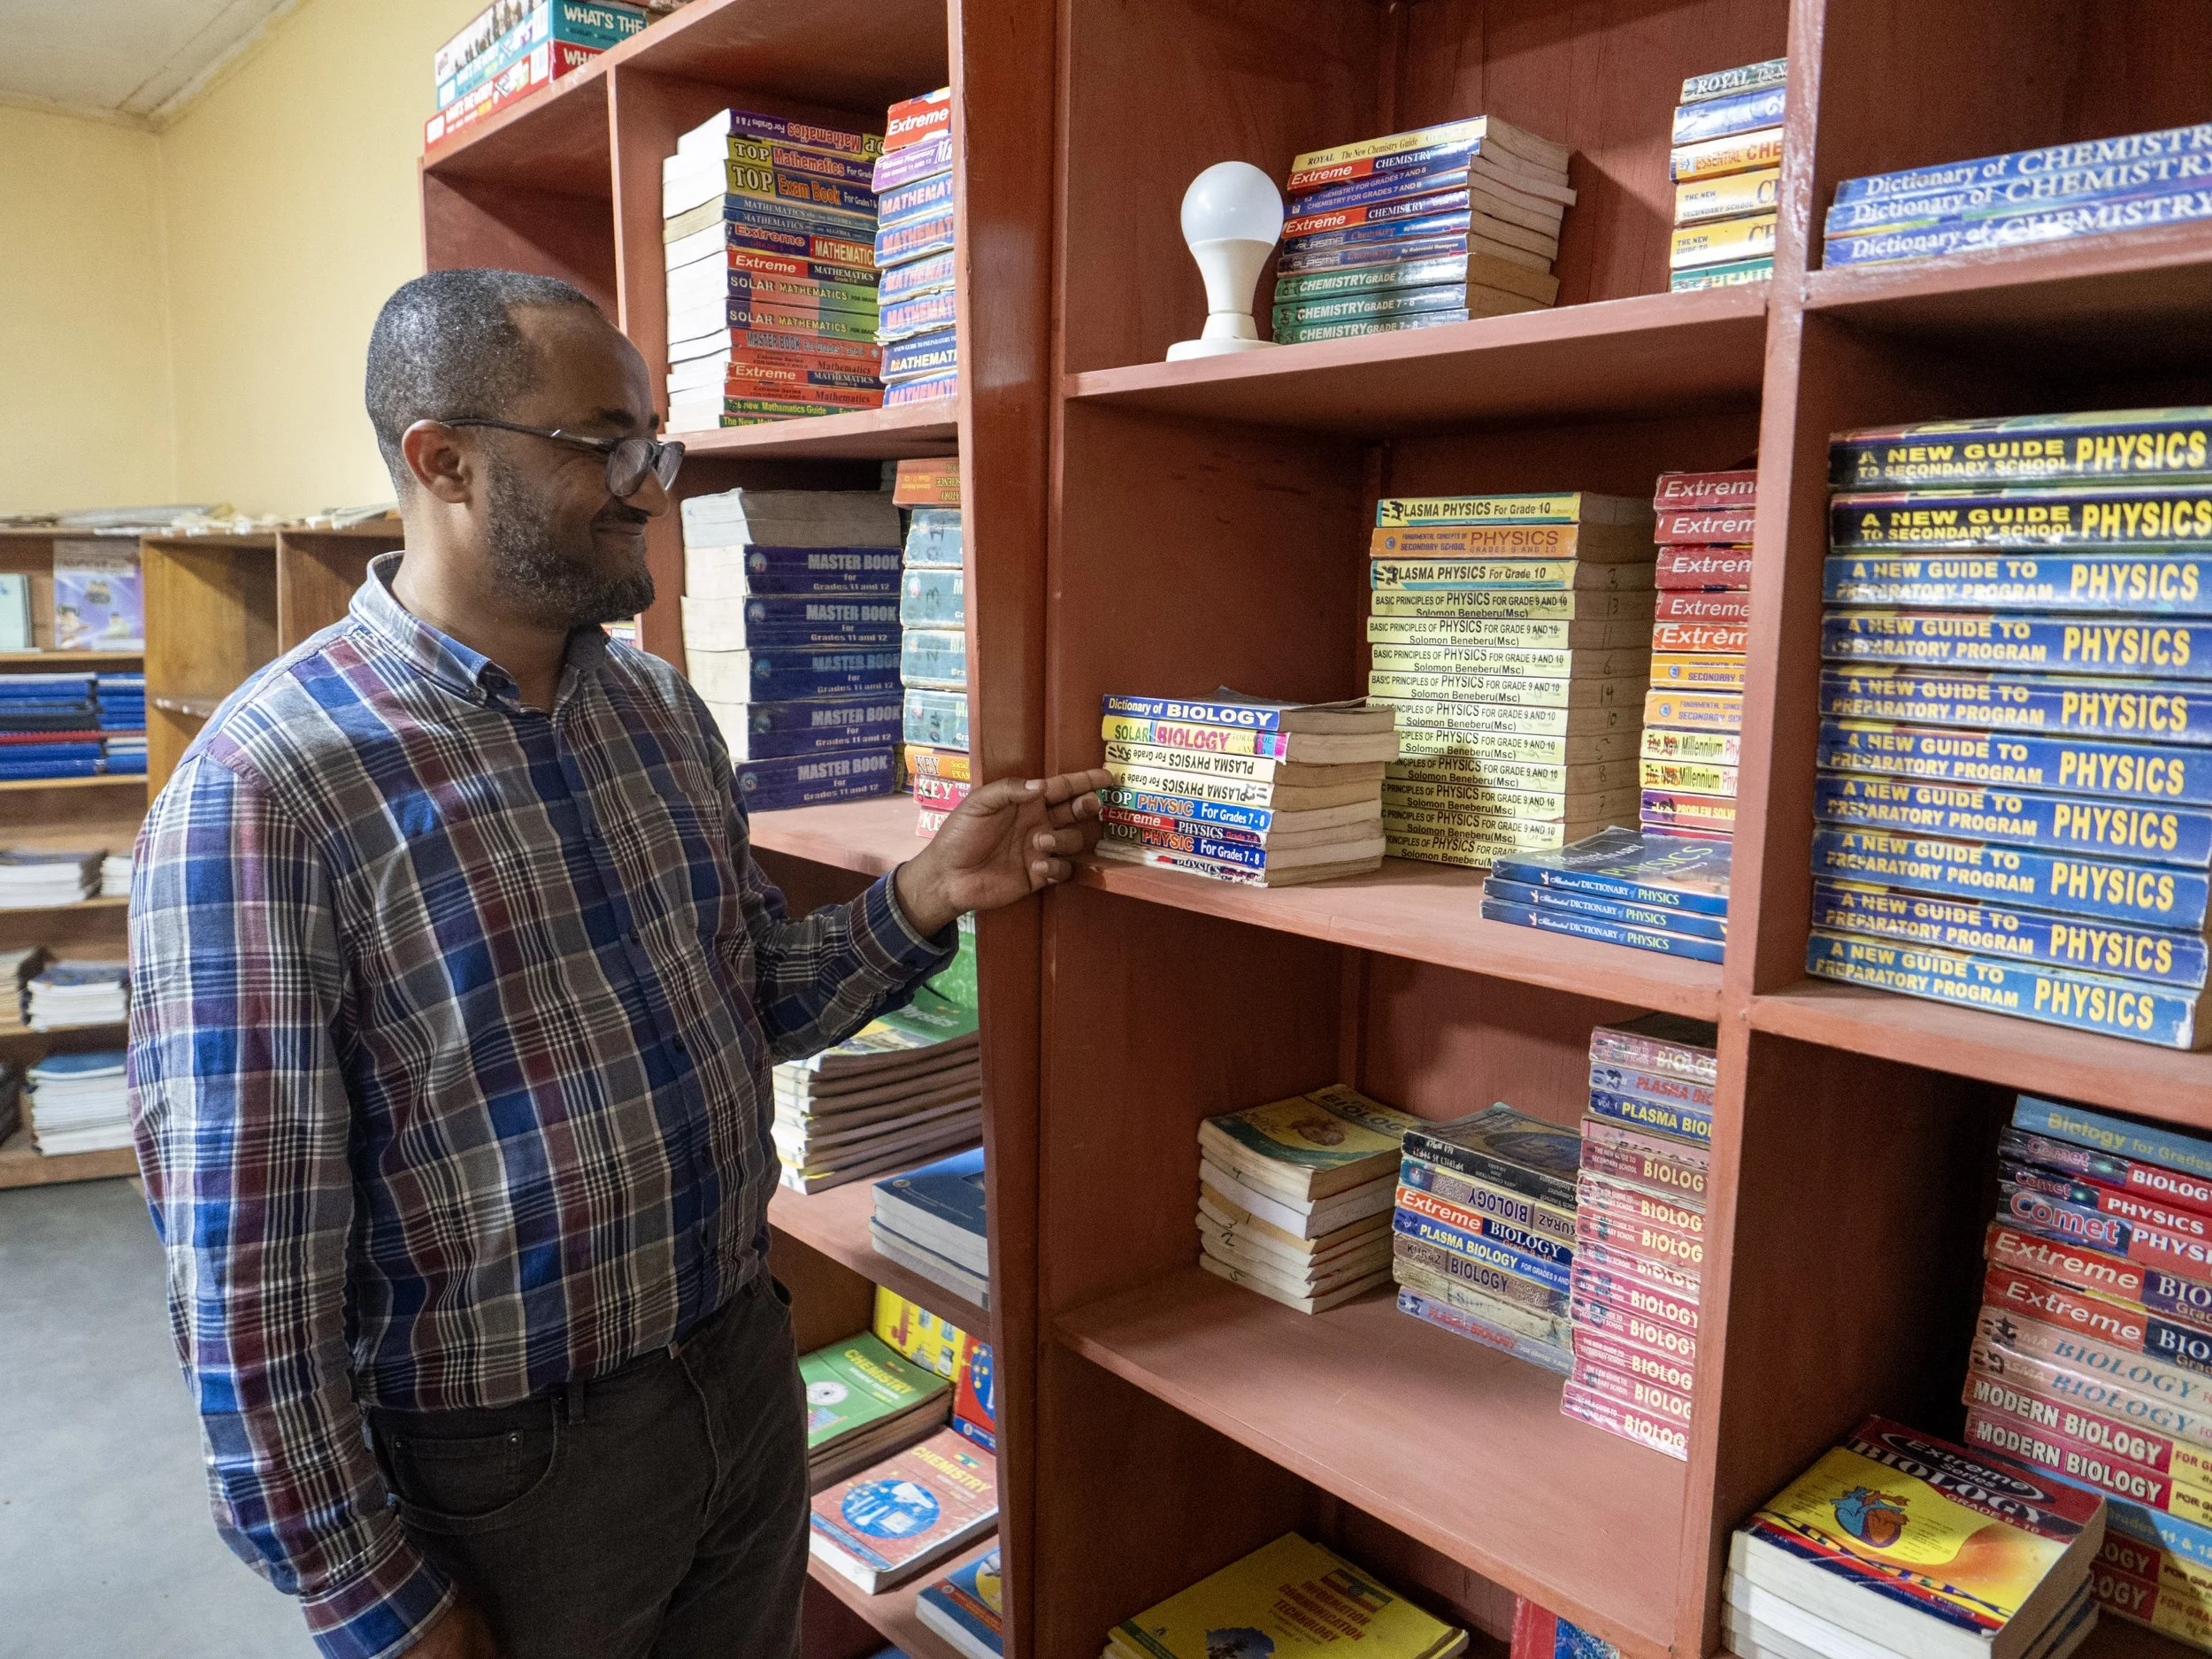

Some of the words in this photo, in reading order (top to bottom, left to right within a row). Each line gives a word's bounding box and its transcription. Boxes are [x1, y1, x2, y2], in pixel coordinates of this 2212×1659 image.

[564, 4, 614, 29] WHAT'S
[617, 15, 644, 35] THE
[1697, 70, 1750, 94] ROYAL
[888, 107, 949, 134] Extreme
[787, 122, 861, 153] Mathematics
[1308, 153, 1334, 166] ROYAL
[1367, 141, 1399, 156] Chemistry
[1400, 136, 1418, 149] Guide
[734, 142, 770, 162] TOP
[773, 147, 845, 176] Mathematics
[1291, 165, 1352, 185] Extreme
[1375, 150, 1431, 169] CHEMISTRY
[732, 165, 772, 190] TOP
[778, 174, 810, 197] Exam
[812, 180, 841, 204] Book
[1866, 165, 1978, 196] Dictionary
[1983, 155, 2009, 177] of
[1369, 202, 1424, 219] CHEMISTRY
[1854, 188, 1971, 225] Dictionary
[1971, 183, 1996, 205] of
[735, 224, 805, 247] Extreme
[815, 238, 875, 265] MATHEMATICS
[1850, 225, 1962, 258] Dictionary
[735, 254, 796, 273] Extreme
[814, 265, 874, 281] MATHEMATICS
[730, 276, 775, 292] SOLAR
[779, 282, 848, 300] MATHEMATICS
[729, 310, 773, 326] SOLAR
[779, 317, 847, 334] MATHEMATICS
[1887, 445, 1954, 464] NEW
[1964, 439, 2064, 460] GUIDE
[2075, 430, 2207, 472] PHYSICS
[1885, 460, 1990, 478] SECONDARY
[1994, 457, 2070, 472] SCHOOL
[1509, 504, 1536, 515] Grade
[1862, 513, 1880, 527] A
[1891, 509, 1957, 527] NEW
[1968, 505, 2070, 525] GUIDE
[1470, 530, 1559, 546] PHYSICS
[1888, 526, 1993, 541] SECONDARY
[1997, 523, 2076, 538] SCHOOL
[807, 553, 861, 571] MASTER
[863, 554, 899, 570] BOOK
[1505, 569, 1531, 579] Grade
[1874, 561, 1921, 579] NEW
[1928, 561, 1999, 579] GUIDE
[2006, 561, 2038, 579] TO
[1962, 584, 2053, 602] PROGRAM
[2070, 563, 2200, 603] PHYSICS
[806, 603, 859, 621] MASTER
[861, 604, 897, 620] BOOK
[1376, 595, 1394, 605] BASIC
[1396, 596, 1433, 606] PRINCIPLES
[1447, 592, 1490, 607] PHYSICS
[1492, 596, 1507, 606] FOR
[1509, 596, 1533, 606] GRADE
[1416, 608, 1455, 617] Solomon
[1459, 608, 1529, 618] Beneberu(Msc)
[1370, 623, 1388, 633] BASIC
[1389, 623, 1426, 633] PRINCIPLES
[1484, 624, 1499, 634] FOR
[1501, 625, 1525, 634] GRADE
[1409, 635, 1448, 645] Solomon
[1450, 636, 1520, 647] Beneberu(Msc)
[1869, 618, 1915, 636] NEW
[1922, 620, 1992, 638] GUIDE
[2000, 622, 2031, 638] TO
[1373, 649, 1393, 659] BASIC
[1394, 649, 1431, 659] PRINCIPLES
[1489, 652, 1504, 662] FOR
[1506, 652, 1530, 663] GRADE
[1955, 643, 2047, 661] PROGRAM
[2062, 626, 2191, 666] PHYSICS
[812, 654, 864, 672] MASTER
[867, 652, 900, 669] BOOK
[1414, 663, 1453, 672] Solomon
[1455, 664, 1525, 675] Beneberu(Msc)
[1486, 680, 1501, 689] FOR
[1502, 680, 1526, 690] GRADE
[1688, 672, 1735, 681] SECONDARY
[1410, 688, 1450, 699] Solomon
[1452, 690, 1520, 703] Beneberu(Msc)
[1868, 680, 1915, 697] NEW
[1922, 682, 1991, 701] GUIDE
[1998, 685, 2029, 703] TO
[811, 709, 864, 726] MASTER
[866, 706, 901, 723] BOOK
[1109, 697, 1150, 713] Dictionary
[1166, 703, 1273, 726] BIOLOGY
[1955, 703, 2045, 725] PROGRAM
[2061, 690, 2188, 732] PHYSICS
[1115, 724, 1150, 741] SOLAR
[1156, 726, 1232, 750] BIOLOGY
[1681, 736, 1723, 757] Millennium
[1868, 734, 1915, 753] NEW
[1921, 739, 1990, 759] GUIDE
[1997, 743, 2028, 762] TO
[797, 762, 850, 781] MASTER
[853, 756, 887, 774] BOOK
[915, 756, 940, 775] KEY
[1215, 757, 1255, 775] PLASMA
[1954, 761, 2042, 783] PROGRAM
[2059, 750, 2185, 795] PHYSICS
[918, 779, 953, 801] KEY
[1864, 783, 1909, 801] NEW
[1916, 788, 1985, 810] GUIDE
[1993, 795, 2023, 814] TO
[1137, 795, 1194, 817] PHYSIC
[1201, 803, 1218, 818] For
[1219, 809, 1247, 825] Grades
[1948, 808, 2037, 837] PROGRAM
[2053, 803, 2177, 850] PHYSICS
[1109, 822, 1138, 839] TOP
[1141, 830, 1194, 851] PHYSIC
[1200, 839, 1217, 855] For
[1217, 845, 1243, 862] Grades
[1914, 841, 1983, 865] GUIDE
[1991, 851, 2020, 871] TO
[1581, 880, 1629, 896] DICTIONARY
[1947, 867, 2034, 895] PROGRAM
[2051, 862, 2176, 912] PHYSICS
[1571, 898, 1617, 916] DICTIONARY
[1913, 902, 1981, 926] GUIDE
[1990, 911, 2019, 932] TO
[1570, 923, 1617, 940] DICTIONARY
[1946, 927, 2033, 956] PROGRAM
[2049, 924, 2173, 975] PHYSICS
[1902, 953, 1967, 979] GUIDE
[1976, 964, 2004, 985] TO
[1932, 979, 2018, 1009] PROGRAM
[2034, 977, 2154, 1032] PHYSICS
[1622, 1102, 1678, 1130] PLASMA
[2047, 1112, 2127, 1150] Biology
[2027, 1138, 2090, 1167] Comet
[2016, 1171, 2071, 1196] Comet
[2108, 1197, 2204, 1235] PHYSICS
[1402, 1189, 1481, 1231] Extreme
[1490, 1220, 1562, 1258] BIOLOGY
[2010, 1192, 2120, 1245] Comet
[1419, 1224, 1463, 1250] PLASMA
[1466, 1240, 1518, 1269] BIOLOGY
[1641, 1229, 1703, 1263] BIOLOG
[1995, 1233, 2139, 1289] Extreme
[2006, 1282, 2142, 1341] Extreme
[844, 1348, 916, 1394] CHEMISTRY
[2053, 1339, 2200, 1399] BIOLOGY
[1973, 1380, 2058, 1428] MODERN
[2064, 1411, 2163, 1465] BIOLOGY
[1976, 1420, 2061, 1468] MODERN
[2065, 1452, 2164, 1504] BIOLOGY
